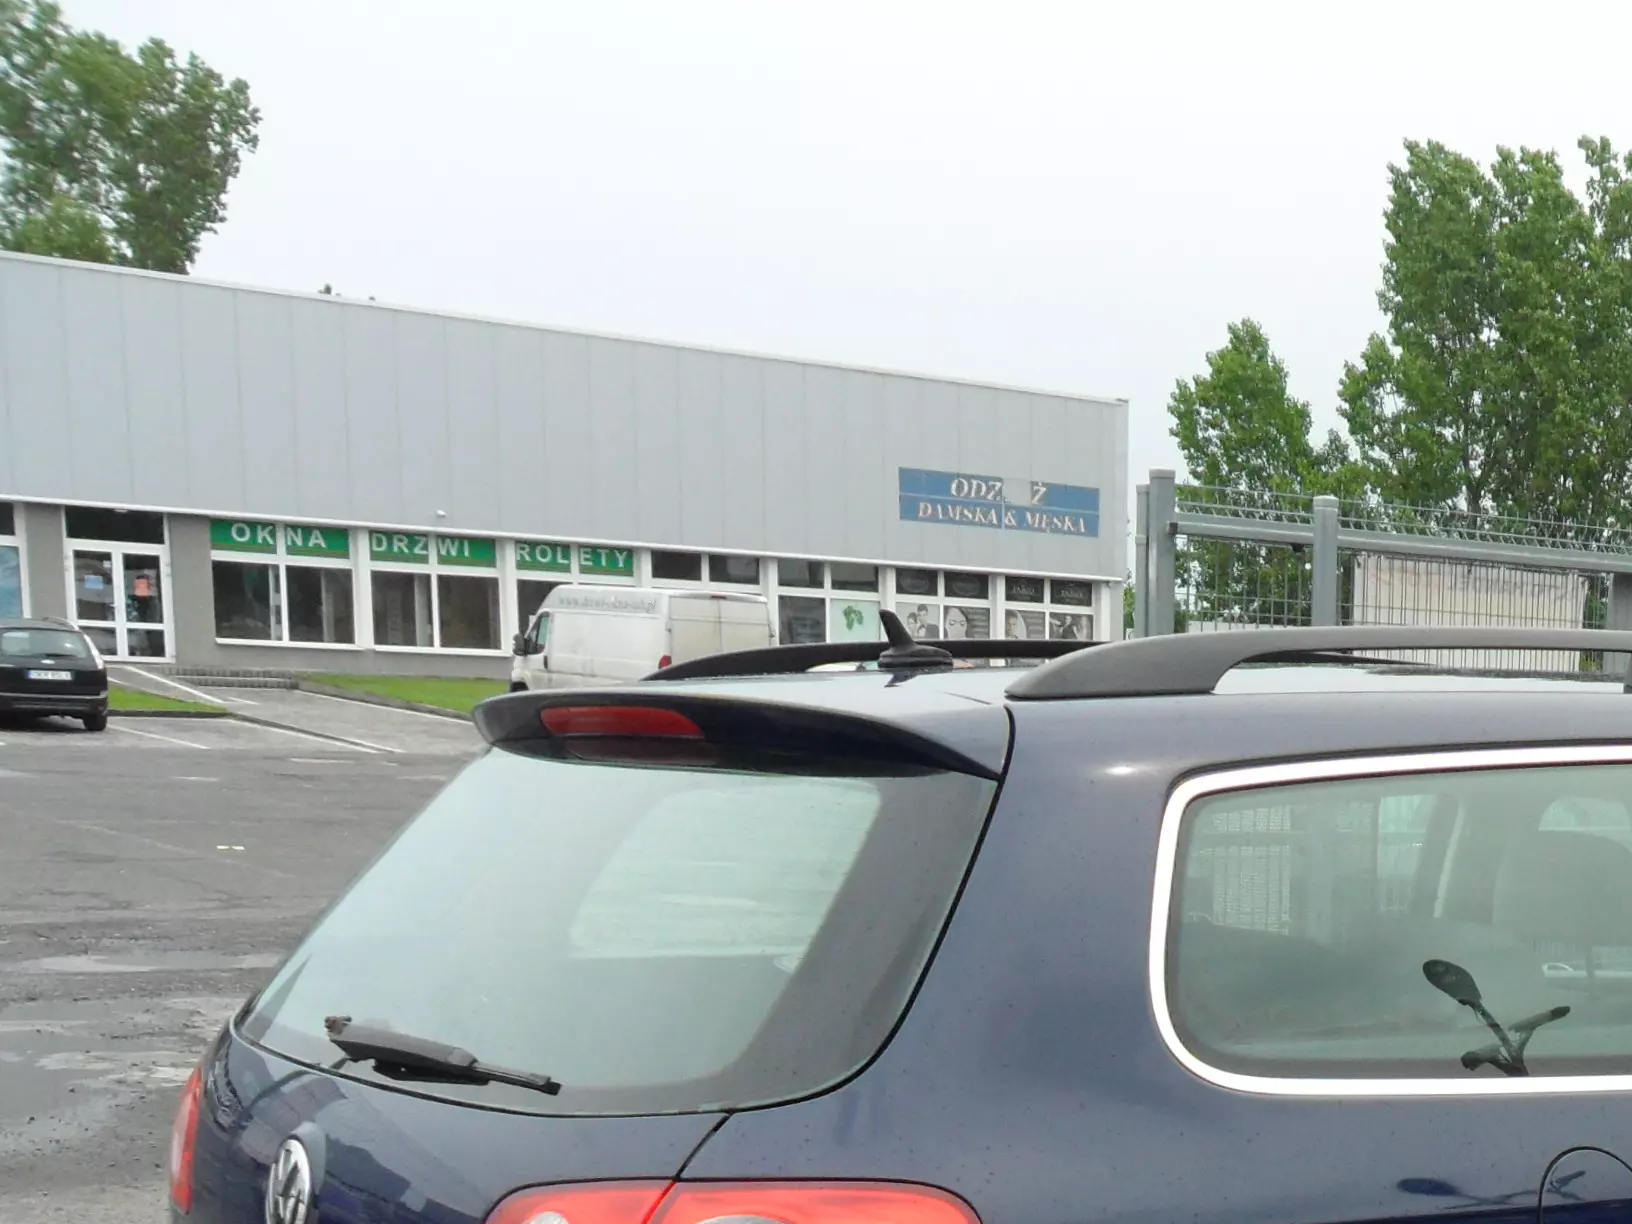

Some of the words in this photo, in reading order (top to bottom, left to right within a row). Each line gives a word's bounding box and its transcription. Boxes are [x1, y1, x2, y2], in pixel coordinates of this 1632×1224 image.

[951, 477, 1047, 505] ODZŻ
[918, 502, 998, 525] DAMSKA
[231, 522, 327, 548] OKNA
[371, 532, 470, 558] DRZWI
[516, 543, 628, 568] ROLETY
